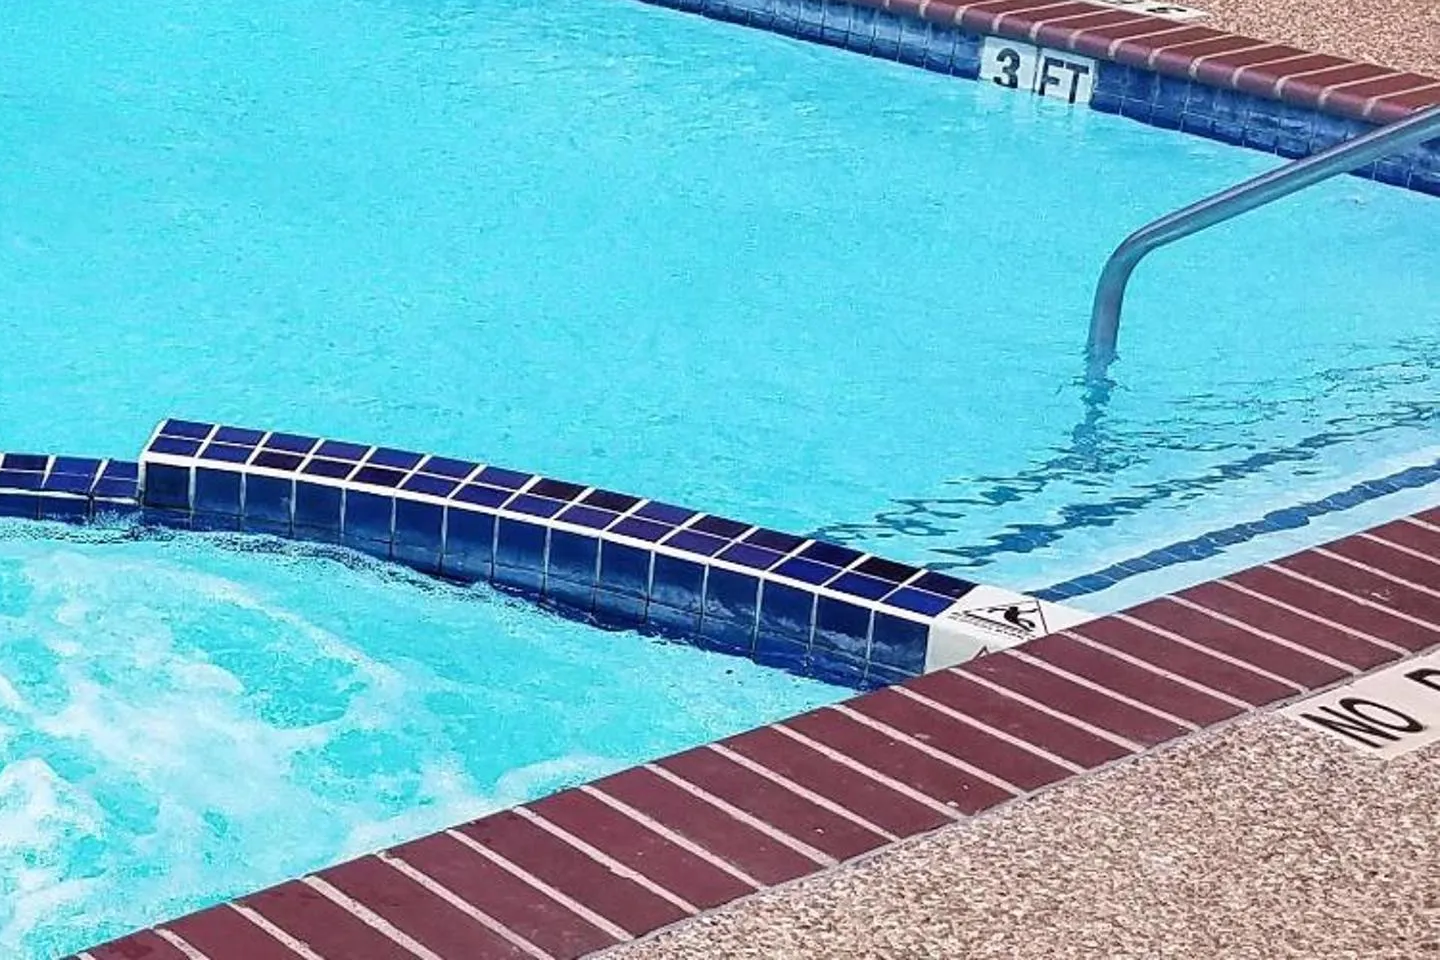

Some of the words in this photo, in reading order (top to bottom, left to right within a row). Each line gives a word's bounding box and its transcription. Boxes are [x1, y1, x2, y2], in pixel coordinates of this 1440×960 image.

[993, 48, 1020, 88] 3
[1038, 55, 1089, 104] FT
[1299, 697, 1424, 749] NO
